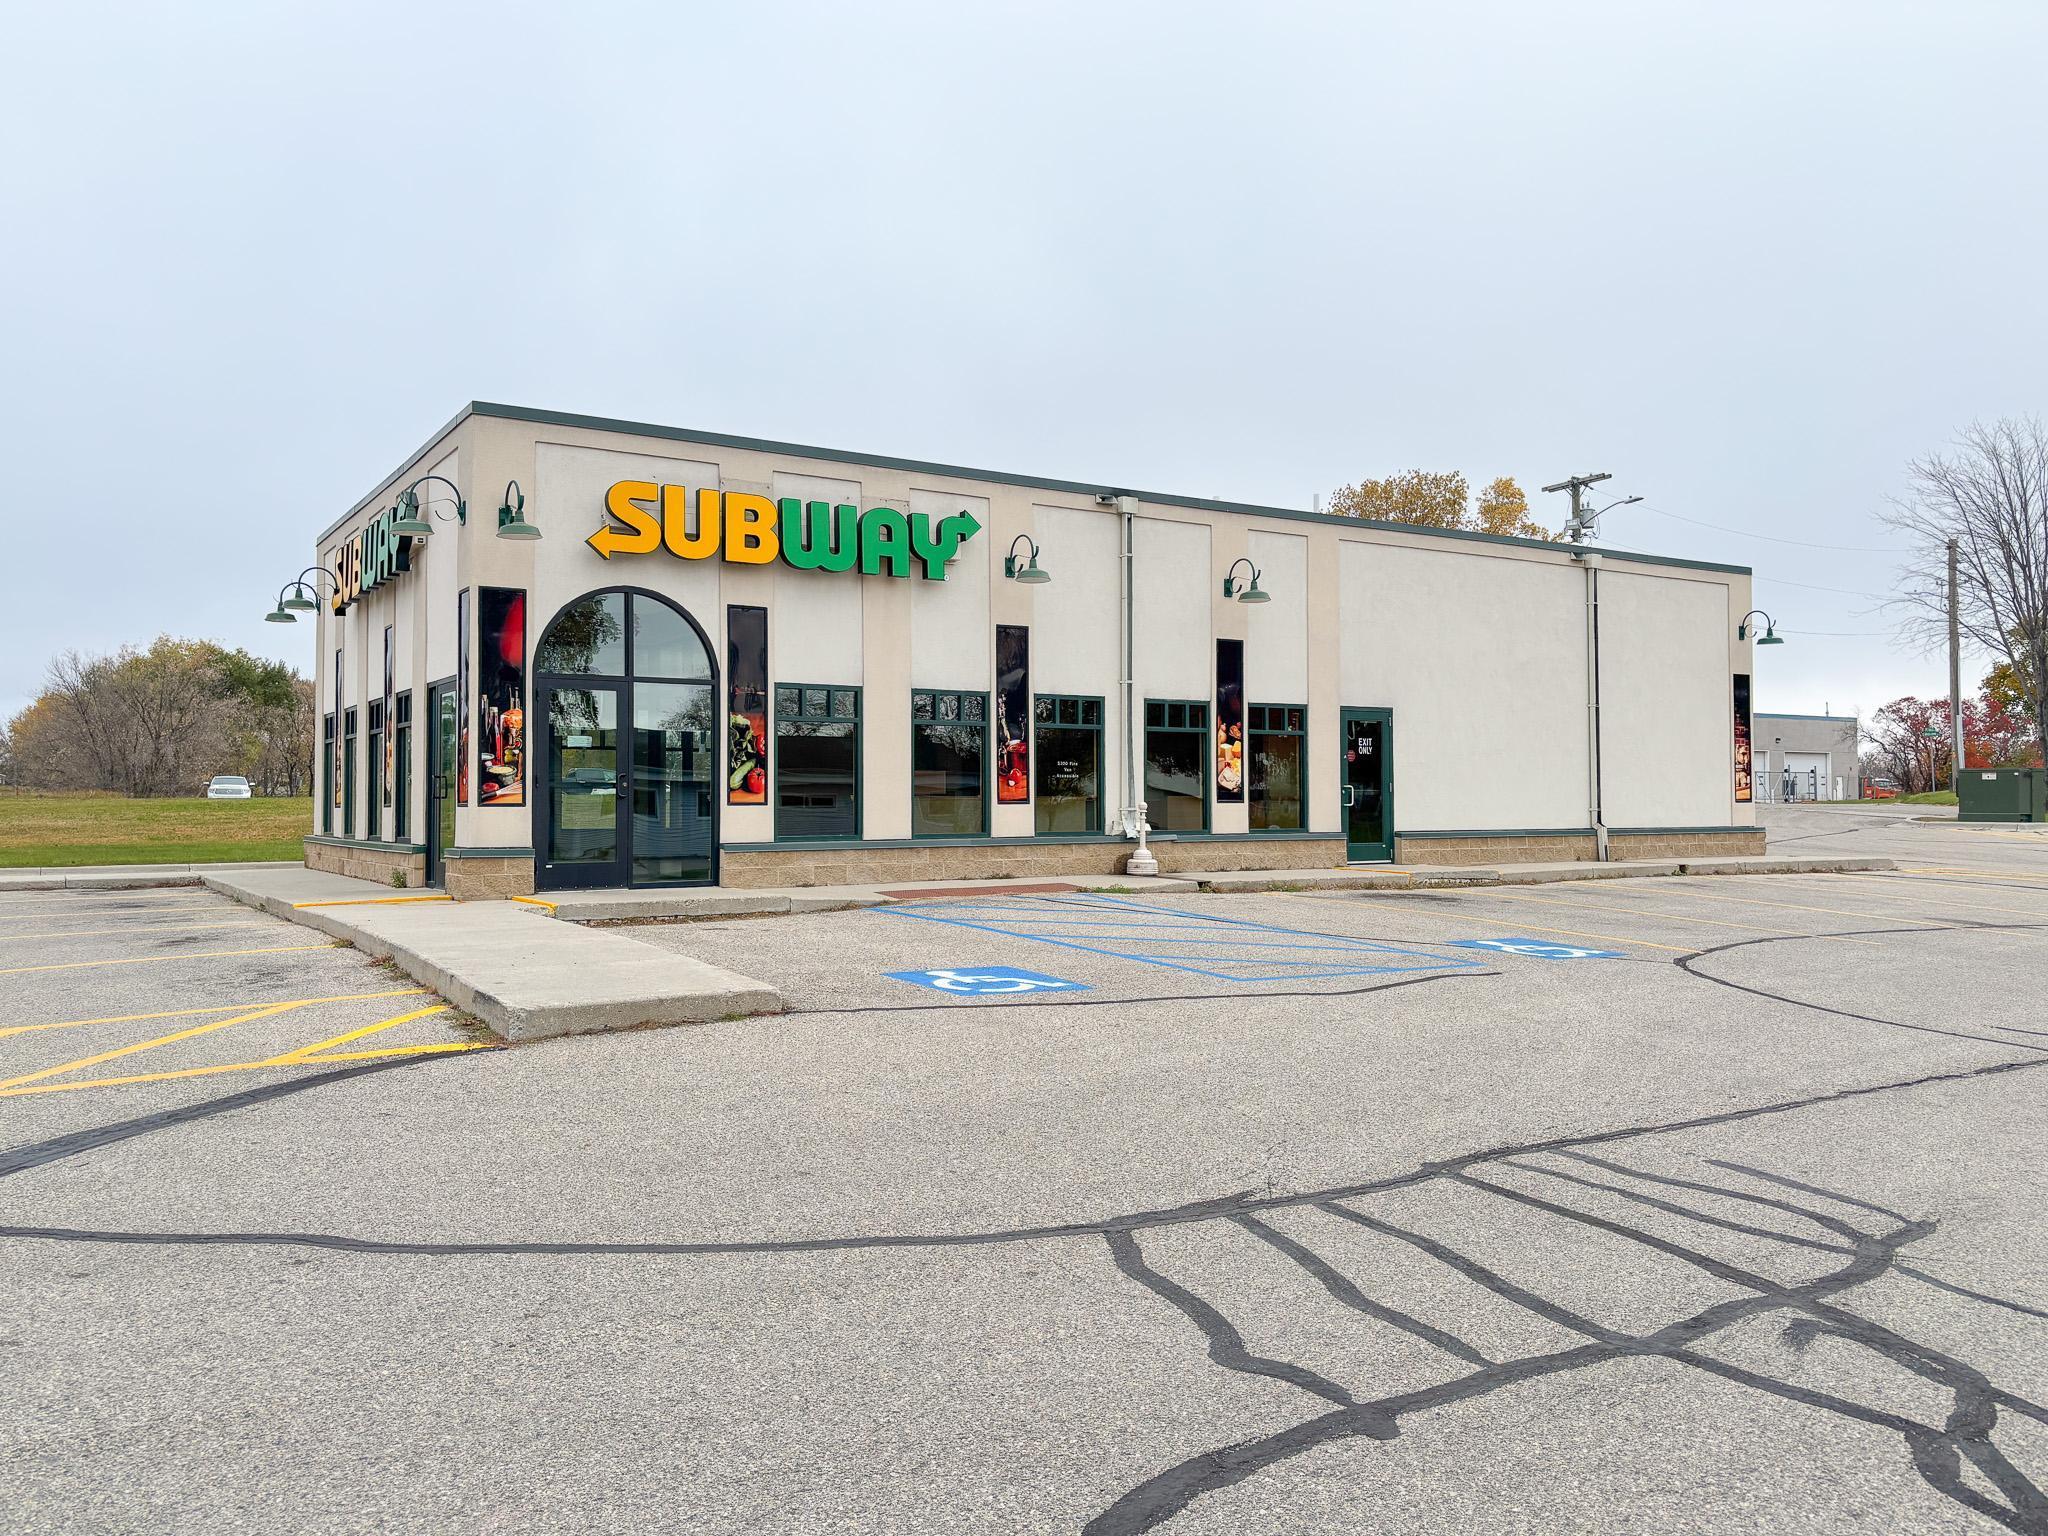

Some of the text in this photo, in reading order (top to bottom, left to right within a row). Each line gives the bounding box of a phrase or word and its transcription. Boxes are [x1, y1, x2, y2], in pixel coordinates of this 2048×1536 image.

[332, 491, 417, 615] SUBWAY
[585, 479, 981, 581] SUBWAY
[1358, 738, 1372, 746] EXIT
[1358, 746, 1372, 754] ONLY
